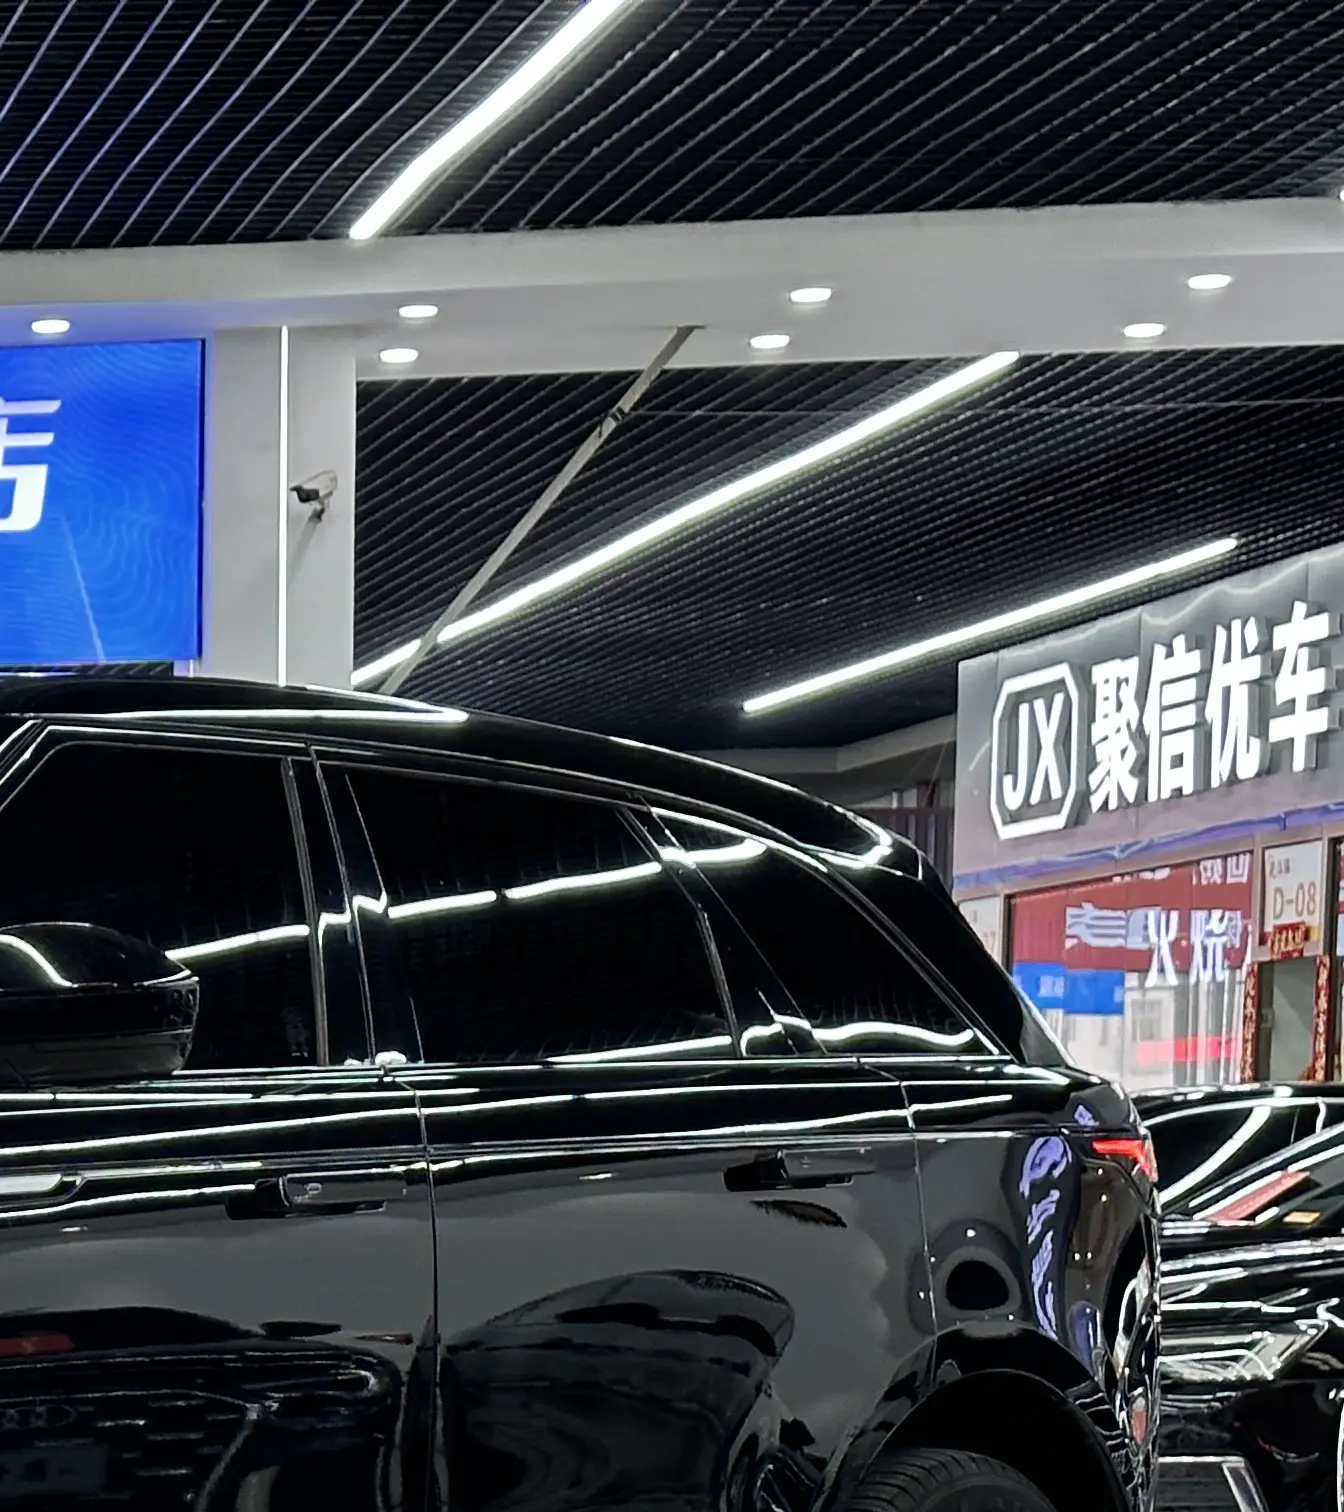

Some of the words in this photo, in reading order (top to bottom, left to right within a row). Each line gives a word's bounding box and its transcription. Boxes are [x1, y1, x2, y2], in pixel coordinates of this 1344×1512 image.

[1002, 691, 1065, 812] JX
[1089, 601, 1330, 812] 聚信优车
[1272, 880, 1317, 922] D-08
